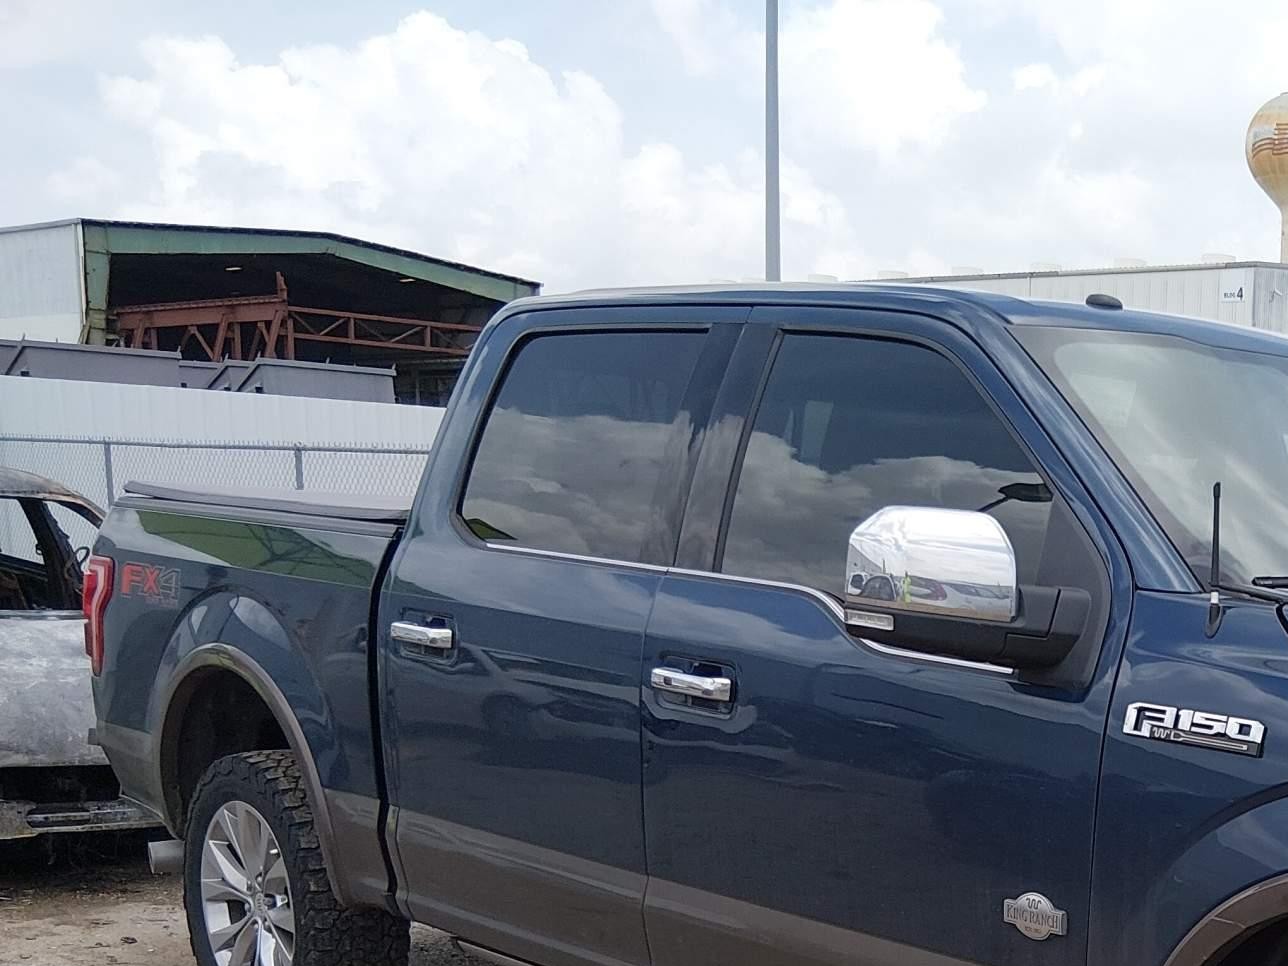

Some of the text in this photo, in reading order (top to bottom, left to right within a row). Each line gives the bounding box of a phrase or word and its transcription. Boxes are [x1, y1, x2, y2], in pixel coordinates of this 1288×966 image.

[1236, 287, 1243, 300] 4
[119, 561, 181, 601] FX4
[1006, 903, 1059, 929] KING RANCH
